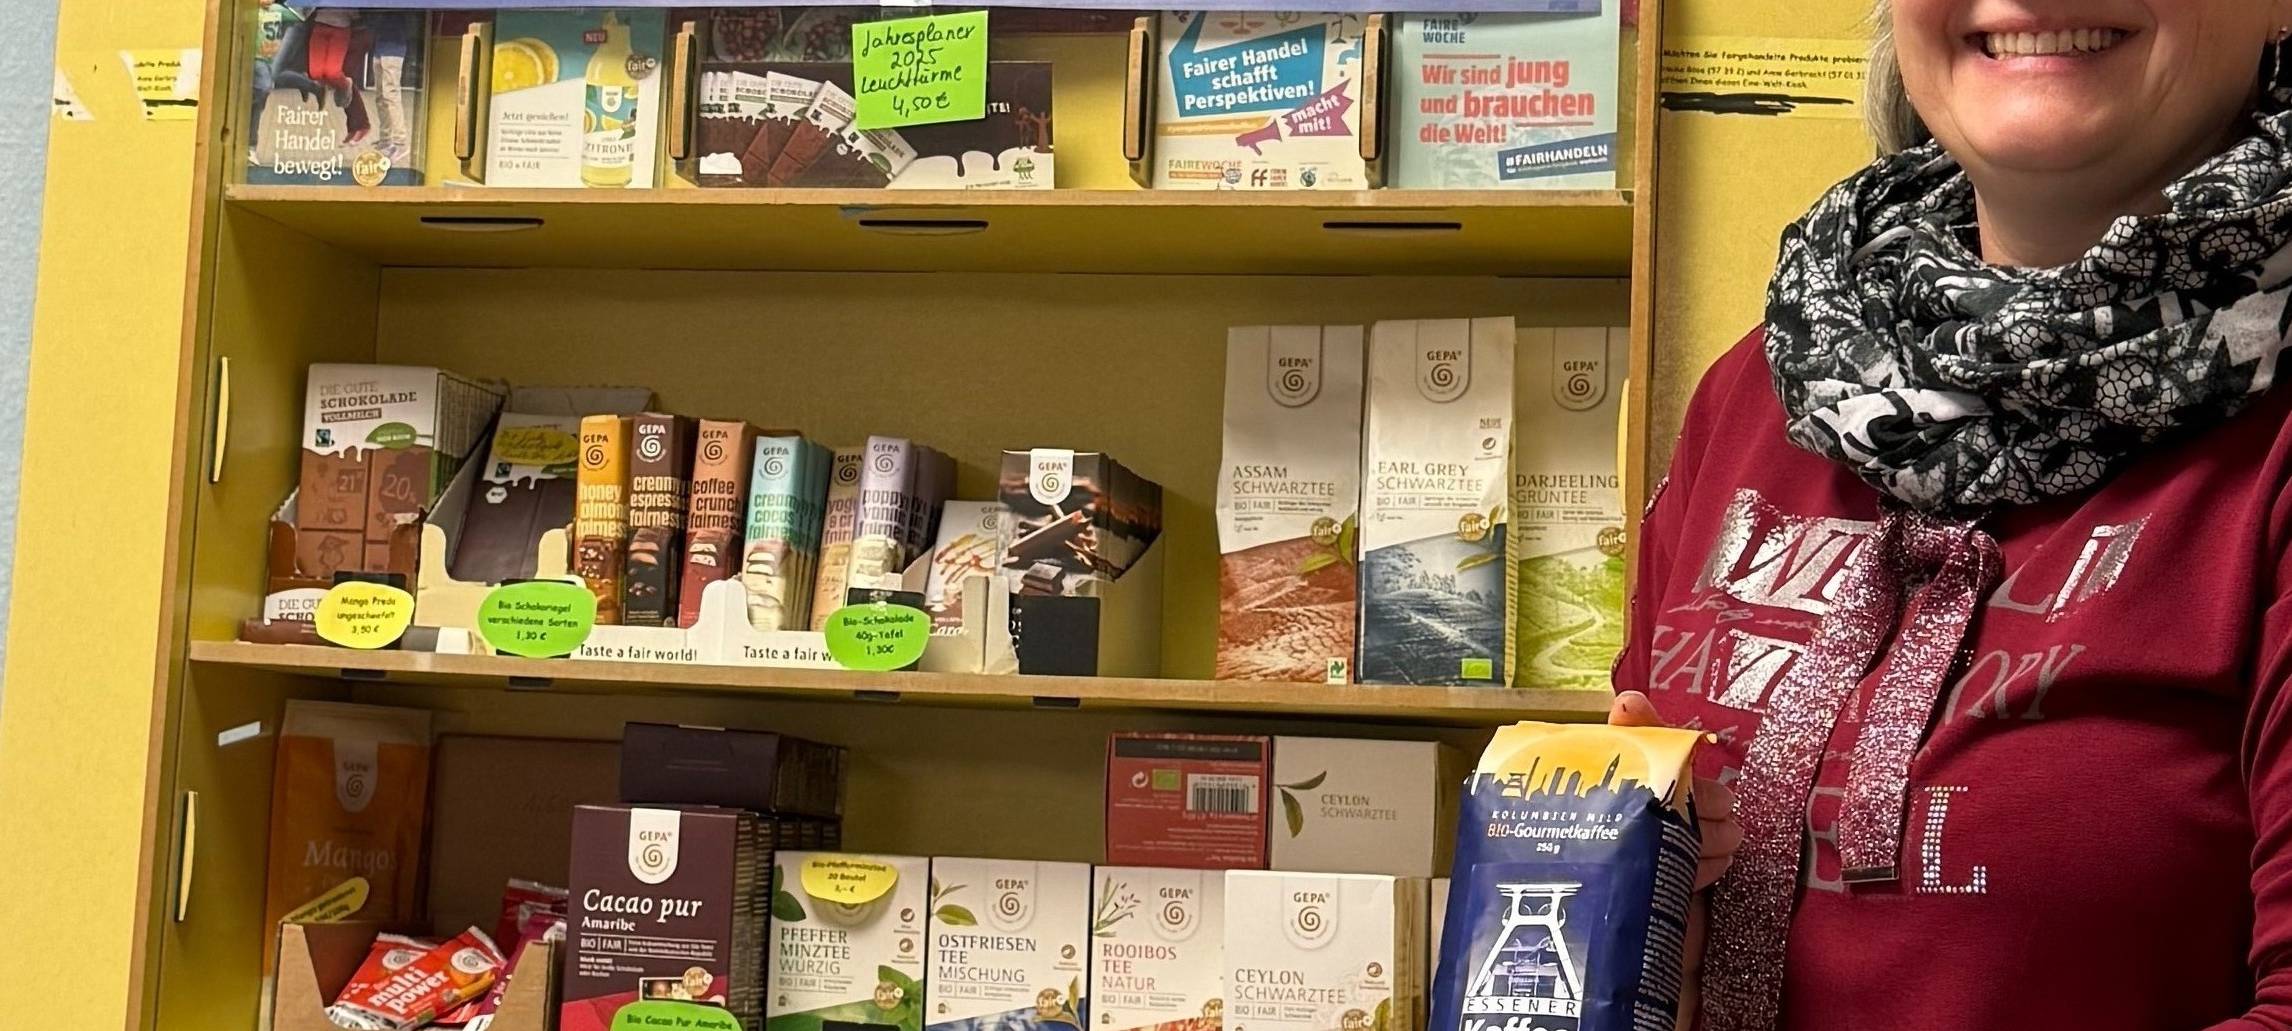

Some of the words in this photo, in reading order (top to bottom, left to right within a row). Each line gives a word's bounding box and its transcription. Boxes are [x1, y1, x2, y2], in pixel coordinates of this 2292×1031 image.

[1423, 19, 1458, 31] FAIRE
[584, 31, 606, 42] NEU
[1423, 32, 1465, 44] WOCHE
[891, 48, 943, 70] 2025
[1183, 55, 1237, 80] Fairer
[1242, 38, 1308, 66] Handel
[1212, 65, 1277, 91] schafft
[1422, 65, 1457, 84] Wir
[1460, 65, 1501, 85] sind
[1505, 56, 1569, 89] jung
[1185, 80, 1314, 110] Perspektiven!
[1421, 95, 1457, 114] und
[1464, 89, 1595, 118] brauchen
[278, 105, 328, 126] Fairer
[1292, 95, 1340, 123] macht
[1298, 119, 1332, 134] mit!
[1420, 123, 1451, 143] die
[1454, 124, 1507, 144] Welt!
[275, 128, 336, 150] Handel
[1506, 144, 1609, 167] #FAIRHANDELN
[274, 152, 344, 180] bewegt!
[356, 160, 378, 176] fair
[321, 391, 417, 409] SCHOKOLADE
[639, 424, 666, 435] GEPA
[702, 430, 728, 439] GEPA
[583, 434, 609, 443] GEPA
[763, 446, 789, 456] GEPA
[873, 443, 900, 453] GEPA
[837, 454, 863, 463] GEPA
[1233, 465, 1287, 478] ASSAM
[1378, 461, 1419, 475] EARL
[1425, 462, 1469, 476] GREY
[693, 477, 735, 495] coffee
[1233, 481, 1335, 496] SCHWARZTEE
[1377, 476, 1483, 492] SCHWARZTEE
[1516, 474, 1619, 489] DARJEELING
[580, 484, 622, 503] honey
[279, 598, 299, 610] DIE
[488, 616, 543, 626] verschiedene
[548, 618, 578, 628] Sorten
[843, 614, 914, 627] Bio-Schokolade
[580, 644, 612, 658] Taste
[617, 647, 623, 658] a
[628, 645, 651, 659] fair
[655, 648, 697, 662] world!
[743, 645, 778, 660] Taste
[783, 648, 790, 659] a
[794, 646, 817, 660] fair
[1321, 793, 1370, 806] CEYLON
[1487, 822, 1619, 840] BIO-Gourmetkaffee
[583, 889, 653, 915] Cacao
[656, 898, 703, 923] pur
[581, 916, 636, 932] Amaribe
[781, 927, 848, 944] PFEFFER
[939, 934, 1037, 952] OSTFRIESEN
[780, 943, 851, 960] MINZTEE
[938, 950, 968, 964] TEE
[1103, 943, 1177, 960] ROOIBOS
[939, 966, 1025, 983] MISCHUNG
[1103, 960, 1132, 974] TEE
[1102, 976, 1155, 990] NATUR
[1235, 968, 1305, 985] CEYLON
[368, 966, 428, 1007] multi
[385, 971, 450, 1014] power
[1235, 985, 1346, 1004] SCHWARZTEE
[1467, 998, 1576, 1015] ESSENER
